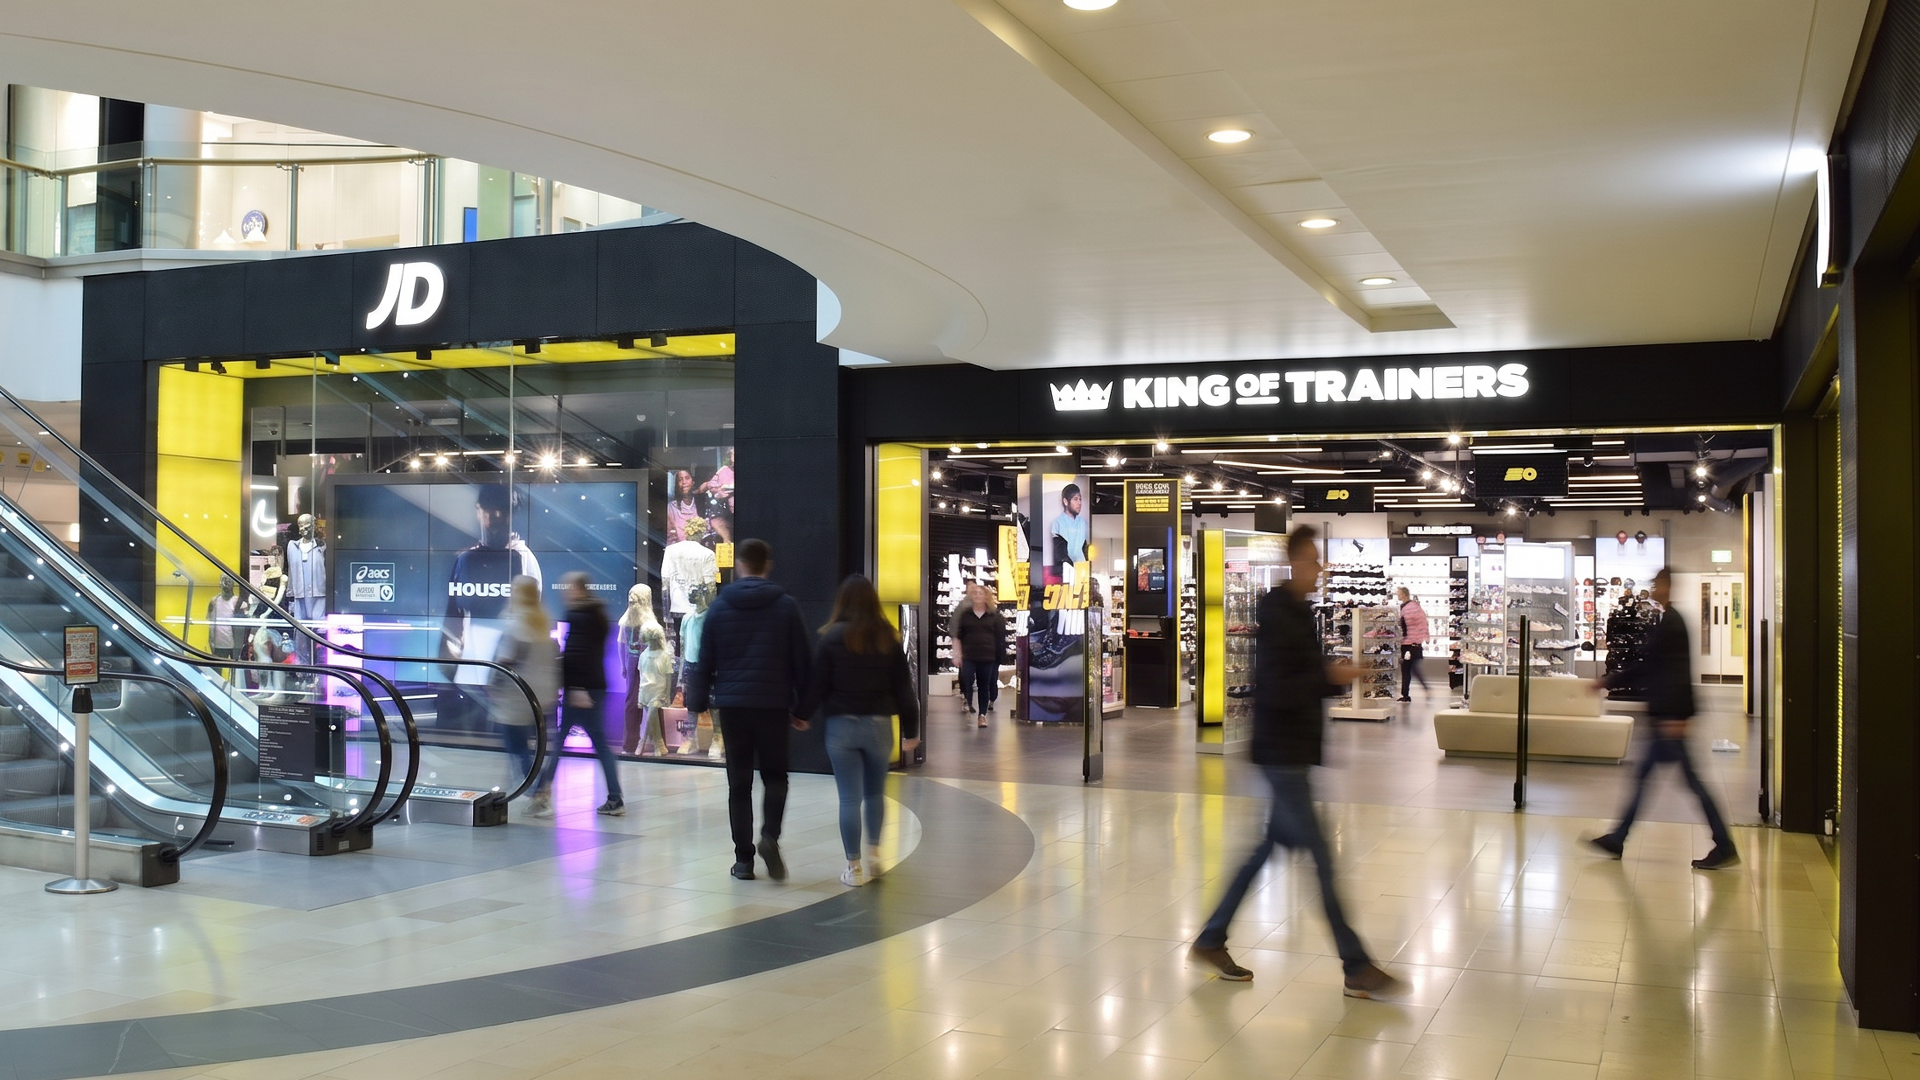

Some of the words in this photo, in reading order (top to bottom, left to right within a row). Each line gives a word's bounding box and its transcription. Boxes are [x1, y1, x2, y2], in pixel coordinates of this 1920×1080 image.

[365, 261, 445, 330] JD
[1123, 375, 1231, 409] KING
[1235, 373, 1280, 405] OF
[1284, 363, 1530, 403] TRAINERS
[448, 581, 512, 598] HOUSE
